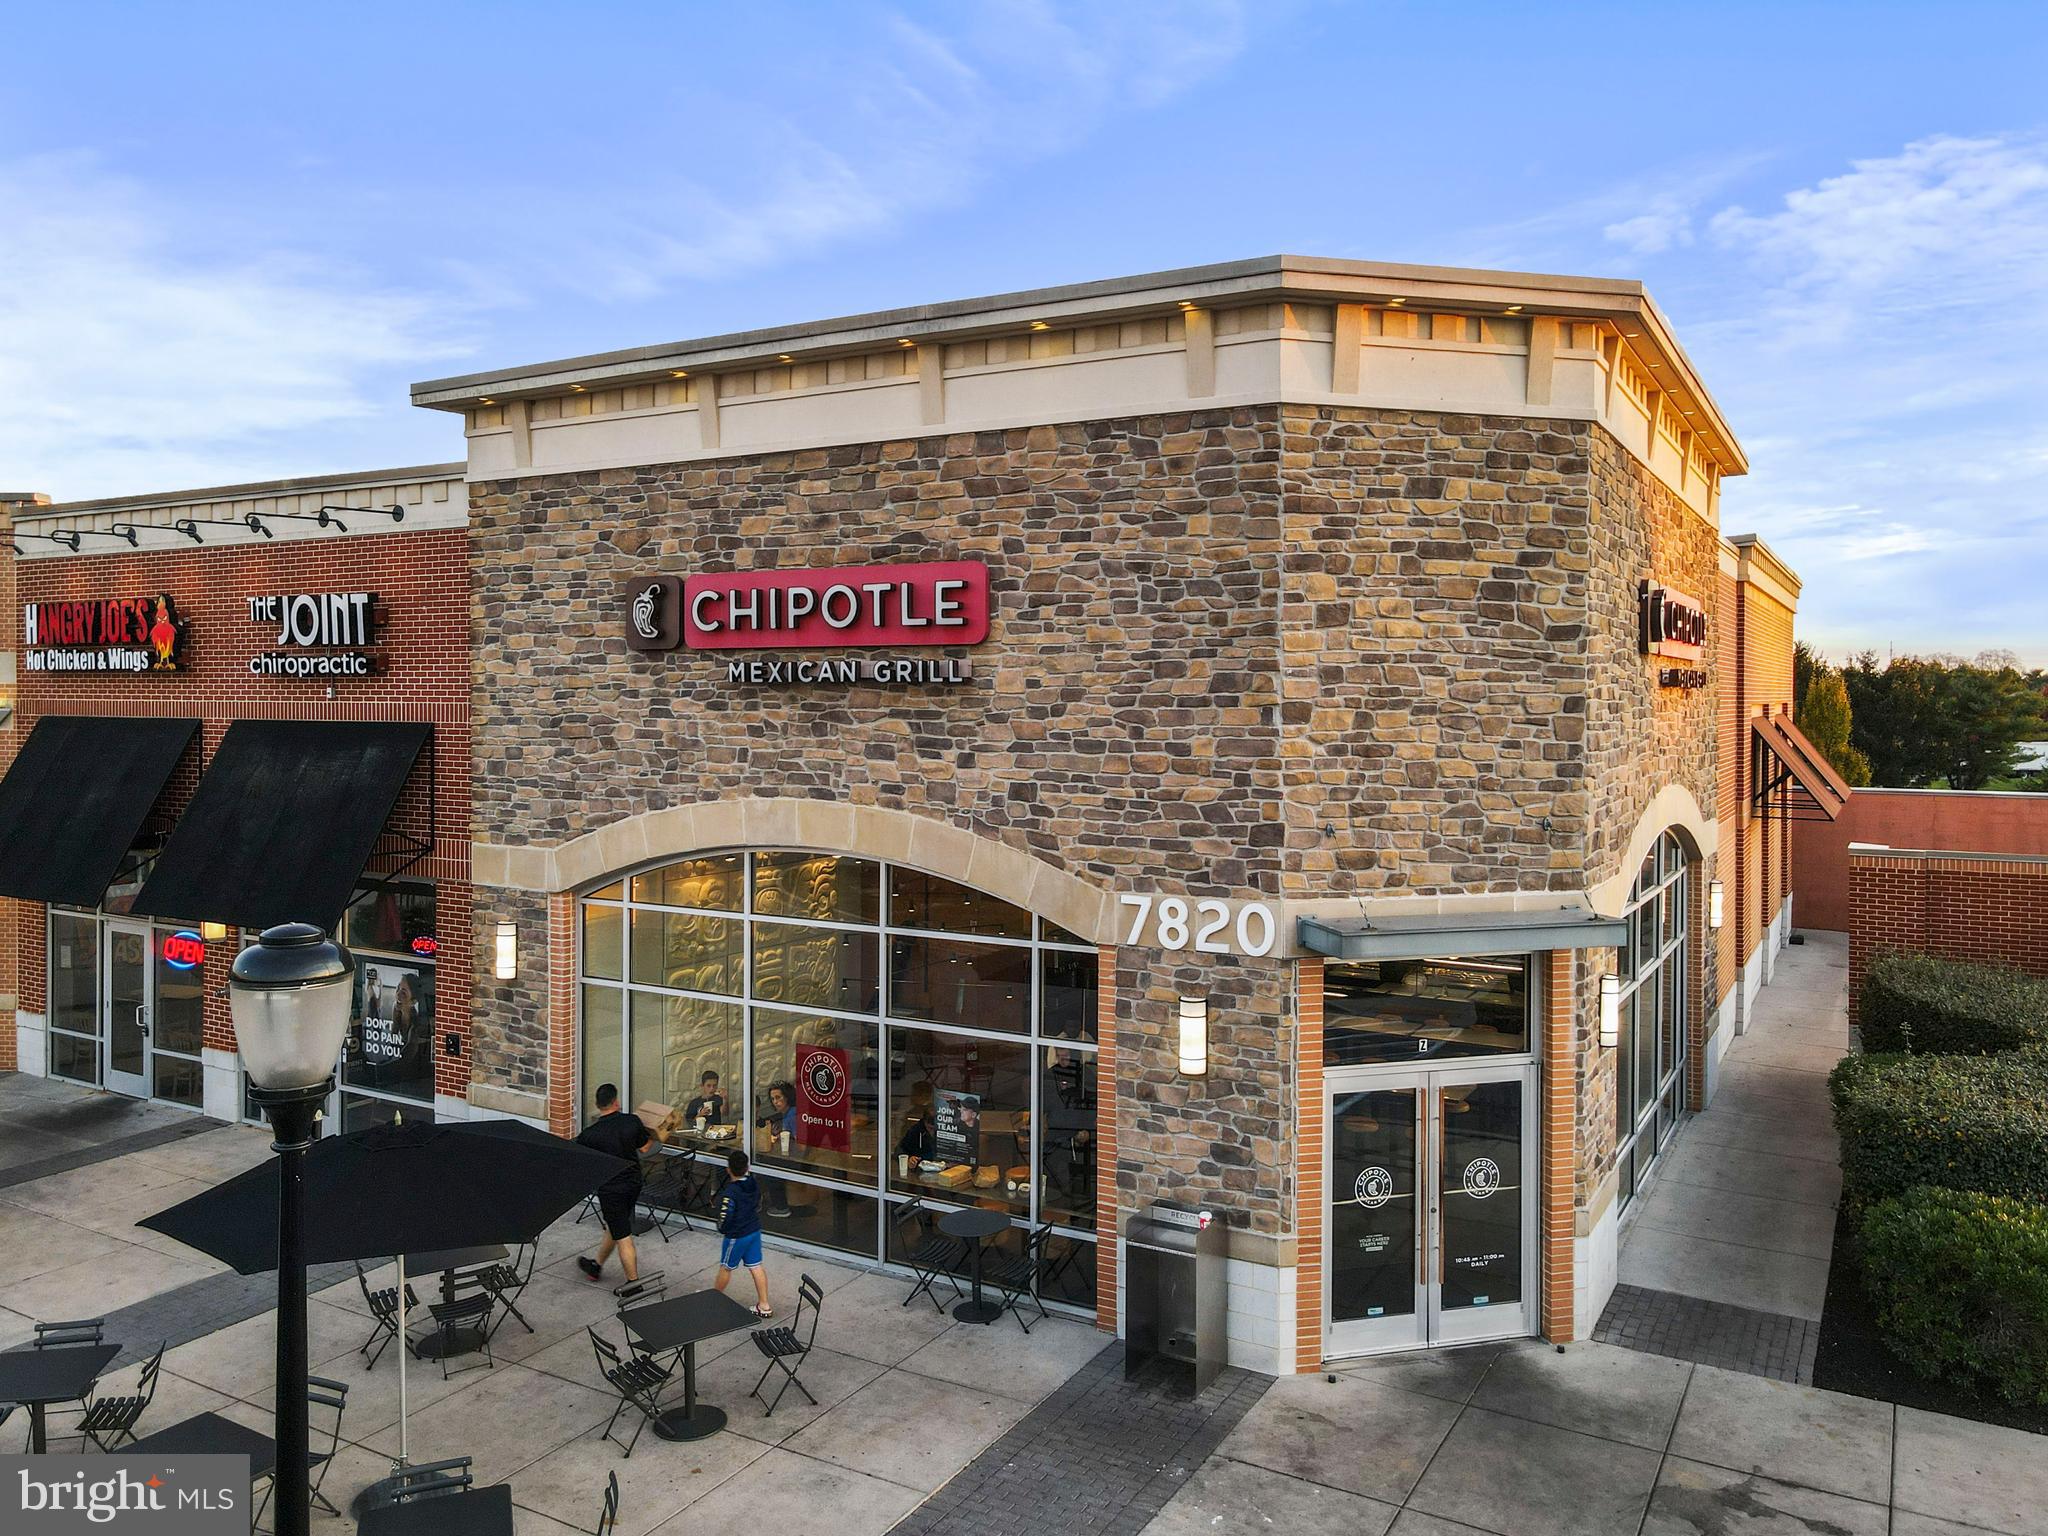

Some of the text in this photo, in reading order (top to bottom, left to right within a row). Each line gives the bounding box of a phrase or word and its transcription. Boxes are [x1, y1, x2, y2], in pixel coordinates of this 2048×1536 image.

[247, 596, 277, 621] THE
[691, 580, 967, 632] CHIPOTLE
[25, 598, 148, 645] HANGRY JOE'S
[278, 593, 368, 646] JOINT
[26, 648, 148, 672] Hot Chicken & Wings
[250, 652, 367, 678] chiropractic
[728, 660, 964, 684] MEXICAN GRILL
[1120, 894, 1276, 957] 7820
[163, 936, 205, 963] OPEN
[411, 938, 437, 951] OPEN
[365, 1017, 394, 1031] DON'T
[366, 1030, 405, 1046] DO PAIN.
[366, 1042, 403, 1059] DO YOU.
[804, 1055, 842, 1078] CHIPOTLE
[801, 1113, 844, 1129] Open to 11
[937, 1106, 955, 1116] JOIN
[937, 1114, 954, 1124] OUR
[937, 1122, 958, 1133] TEAM
[1358, 1169, 1390, 1186] CHIPOTLE
[1466, 1160, 1497, 1177] CHIPOTLE
